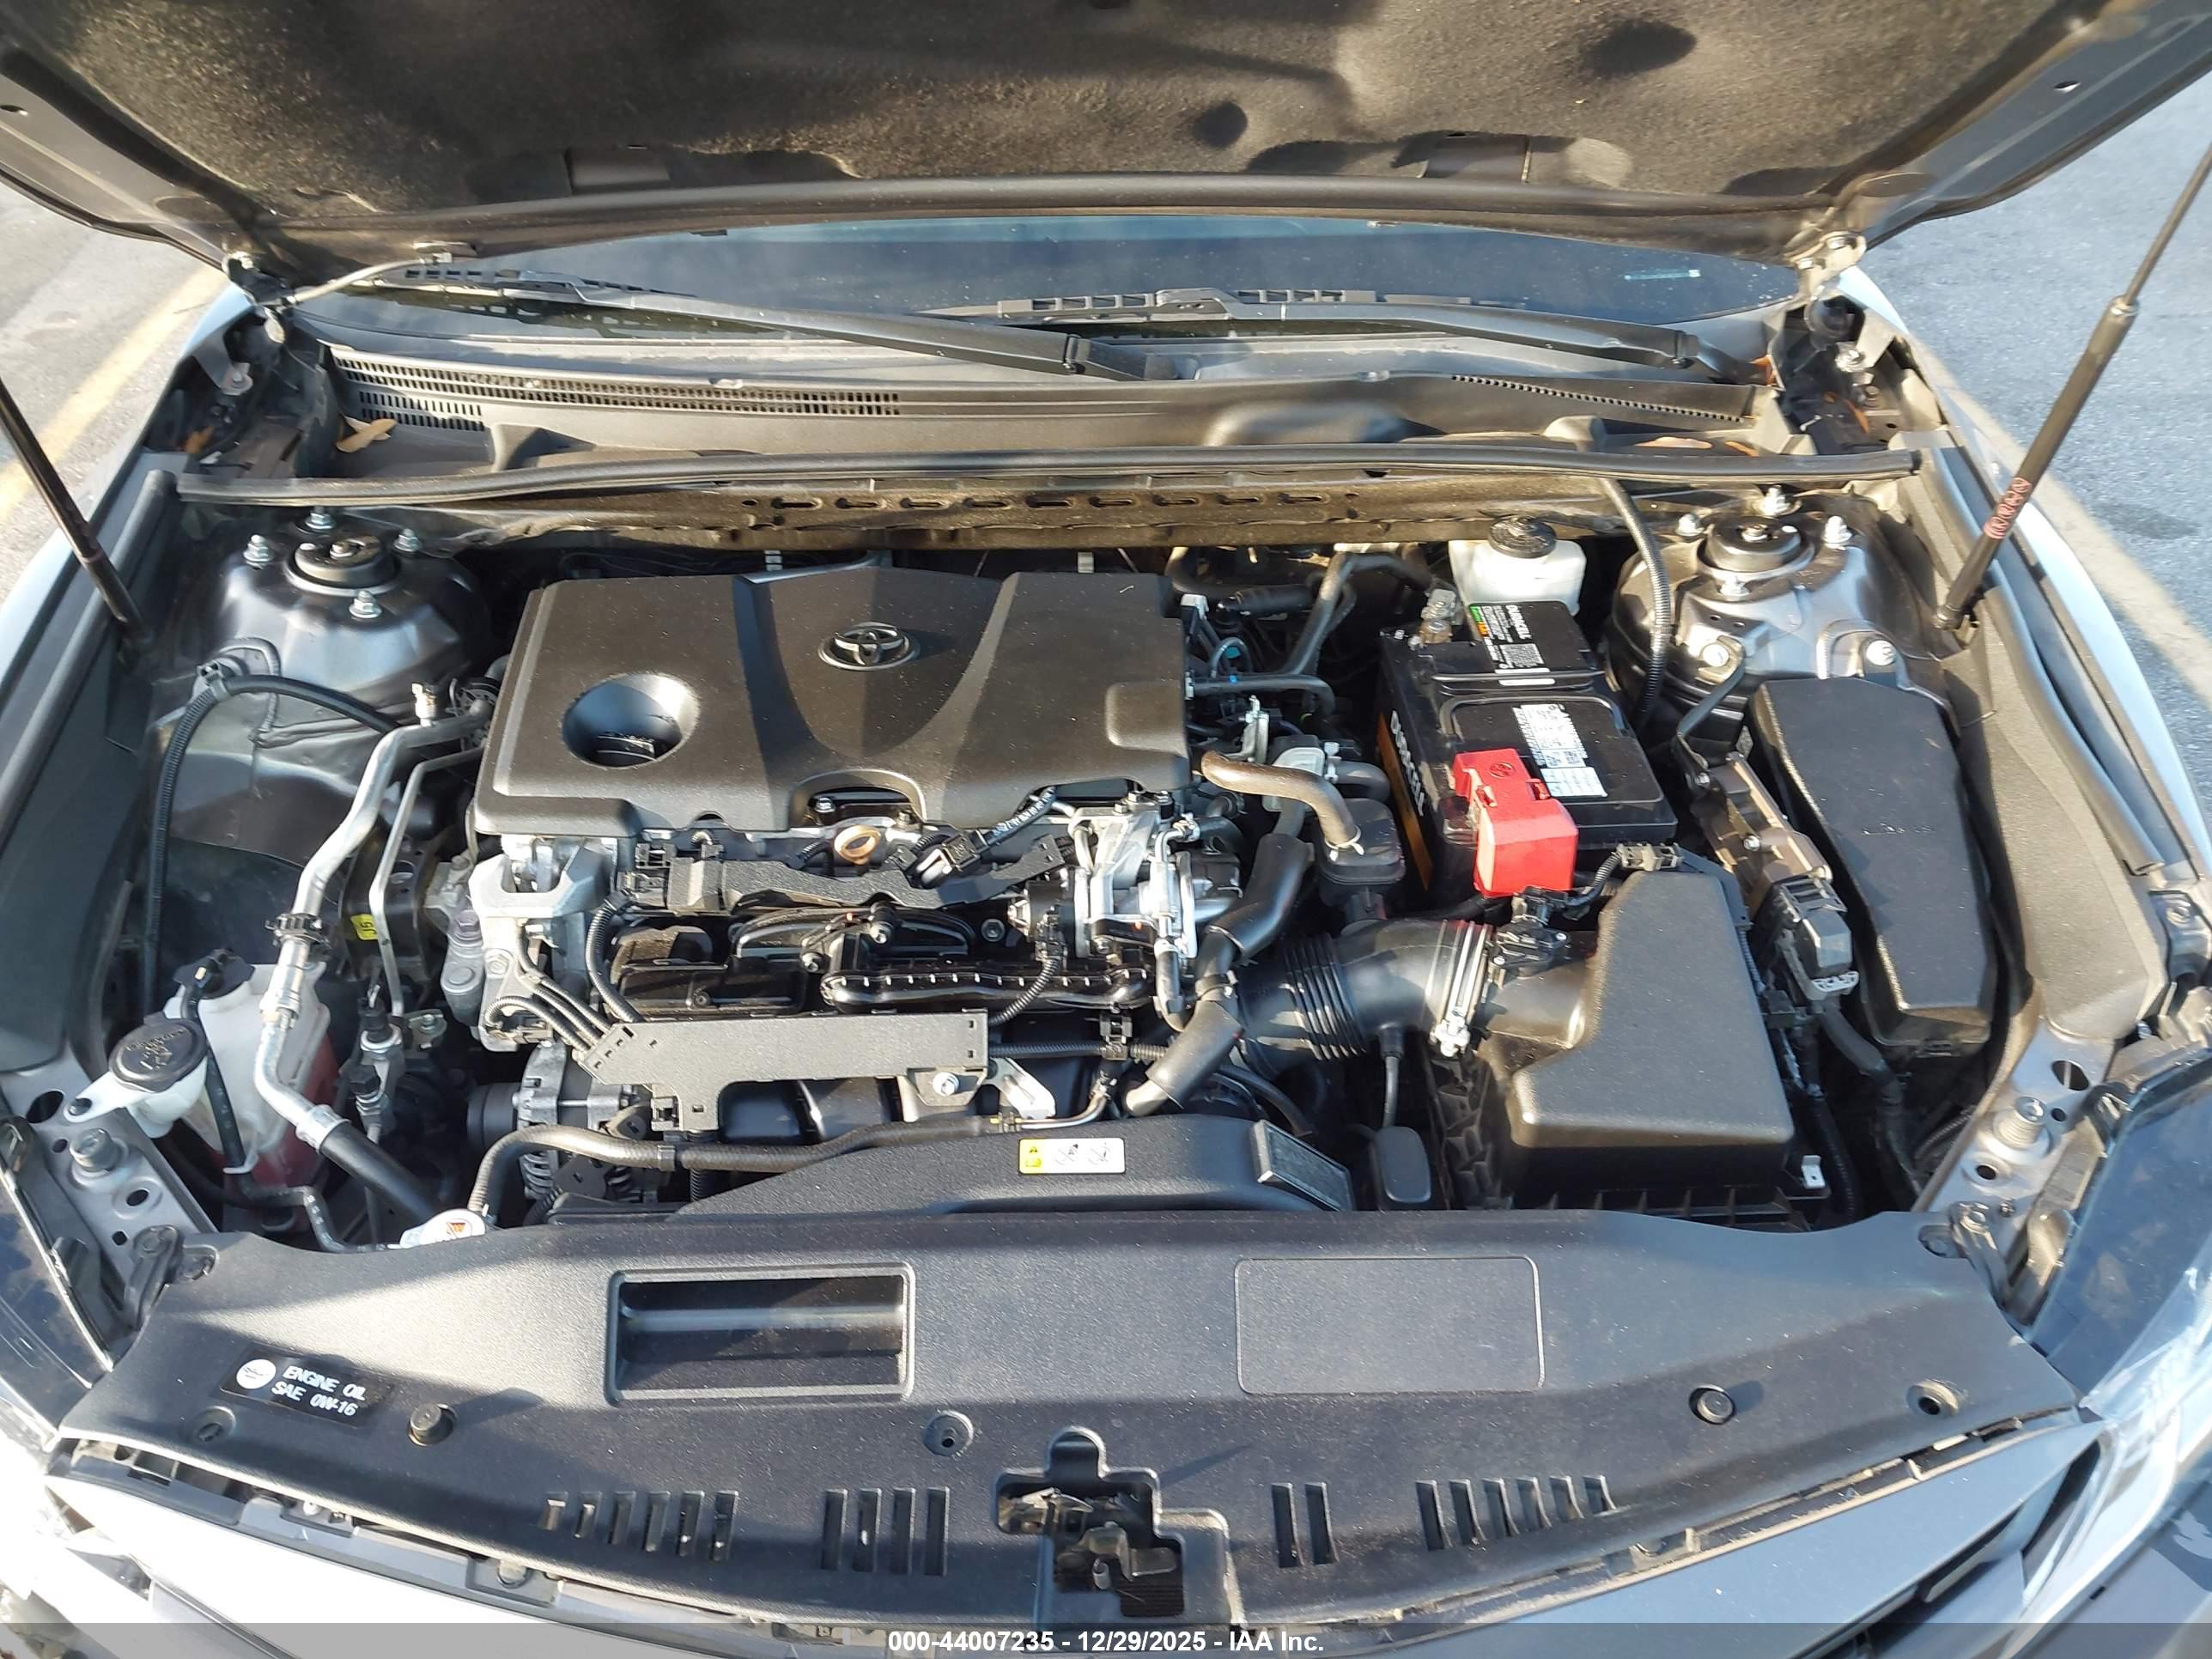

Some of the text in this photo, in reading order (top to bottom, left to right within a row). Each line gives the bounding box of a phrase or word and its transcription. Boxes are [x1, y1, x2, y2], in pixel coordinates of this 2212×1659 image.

[271, 1381, 359, 1417] SAE 0W-16
[283, 1365, 367, 1401] ENGINE OIL
